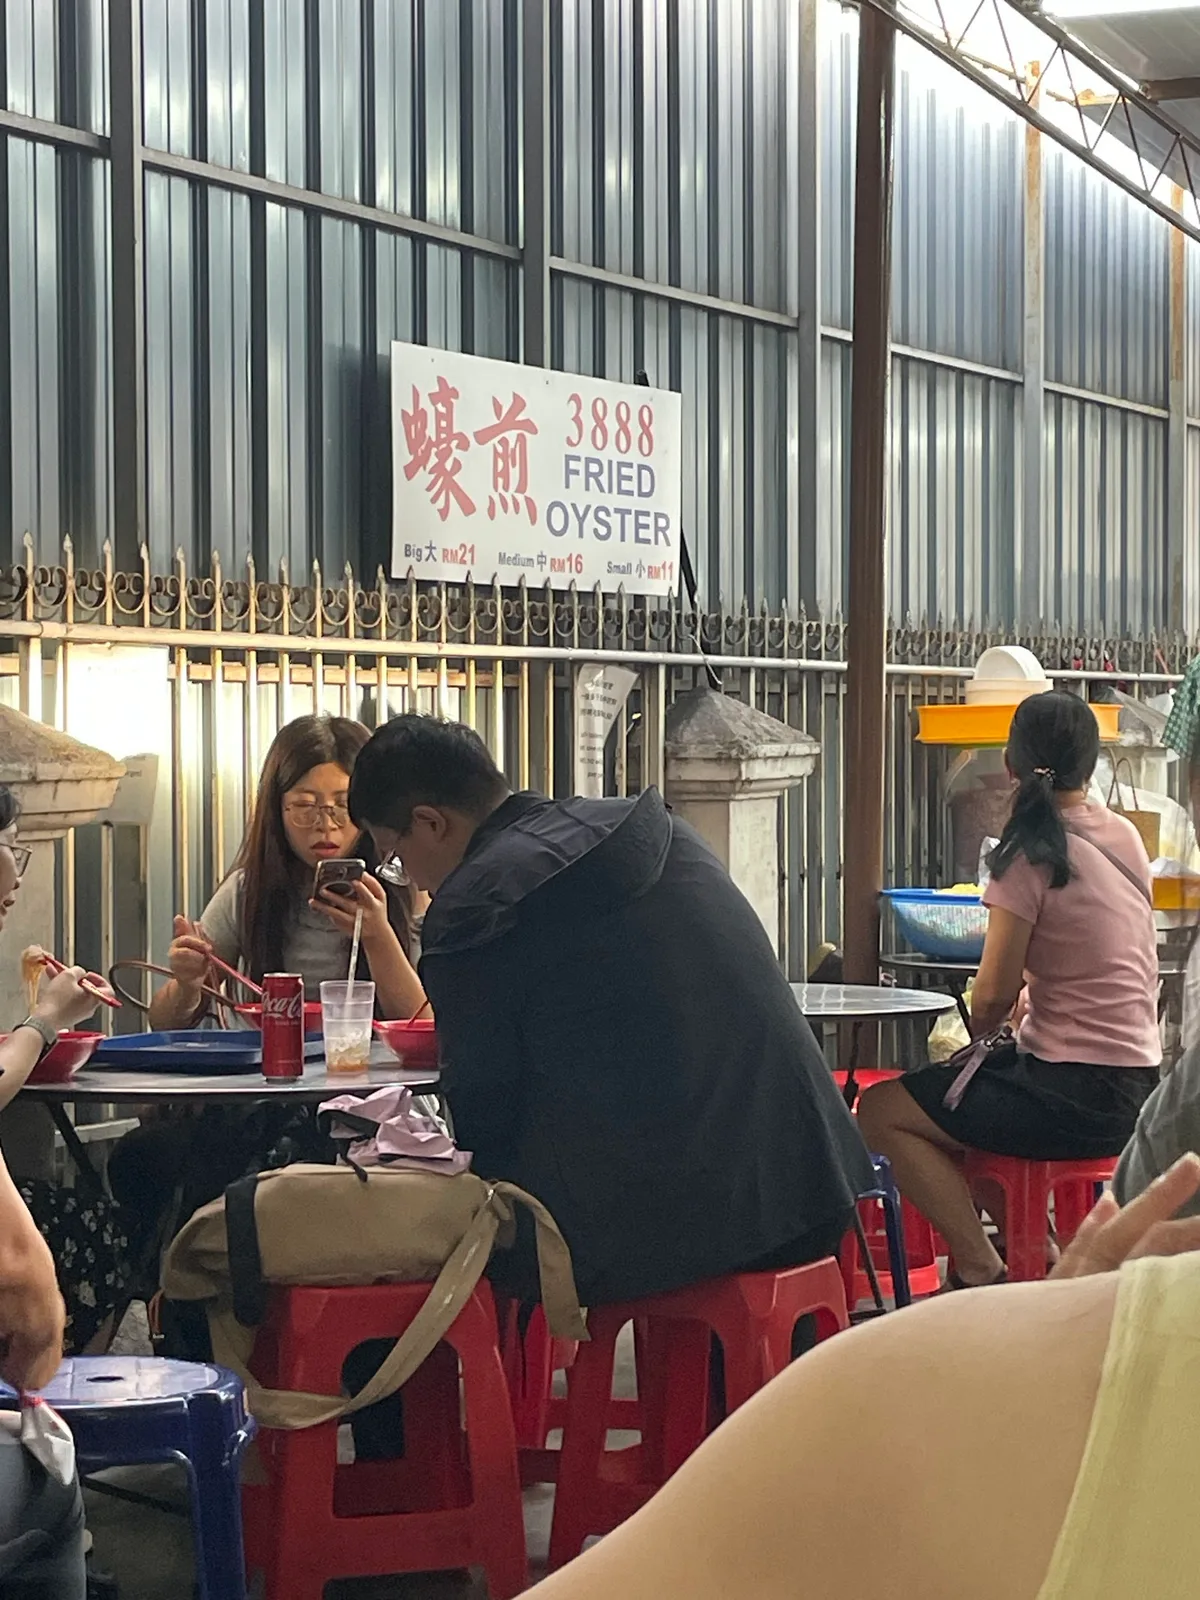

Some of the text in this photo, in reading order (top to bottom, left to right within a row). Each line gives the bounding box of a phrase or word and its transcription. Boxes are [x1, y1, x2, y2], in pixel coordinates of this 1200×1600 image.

[566, 393, 654, 457] 3888
[401, 376, 539, 526] 蠔煎
[564, 454, 655, 498] FRIED
[546, 501, 671, 547] OYSTER
[404, 540, 475, 565] Big 大 RM21
[498, 550, 583, 574] Medium 中 RM16
[607, 559, 674, 580] Small 小 RM11
